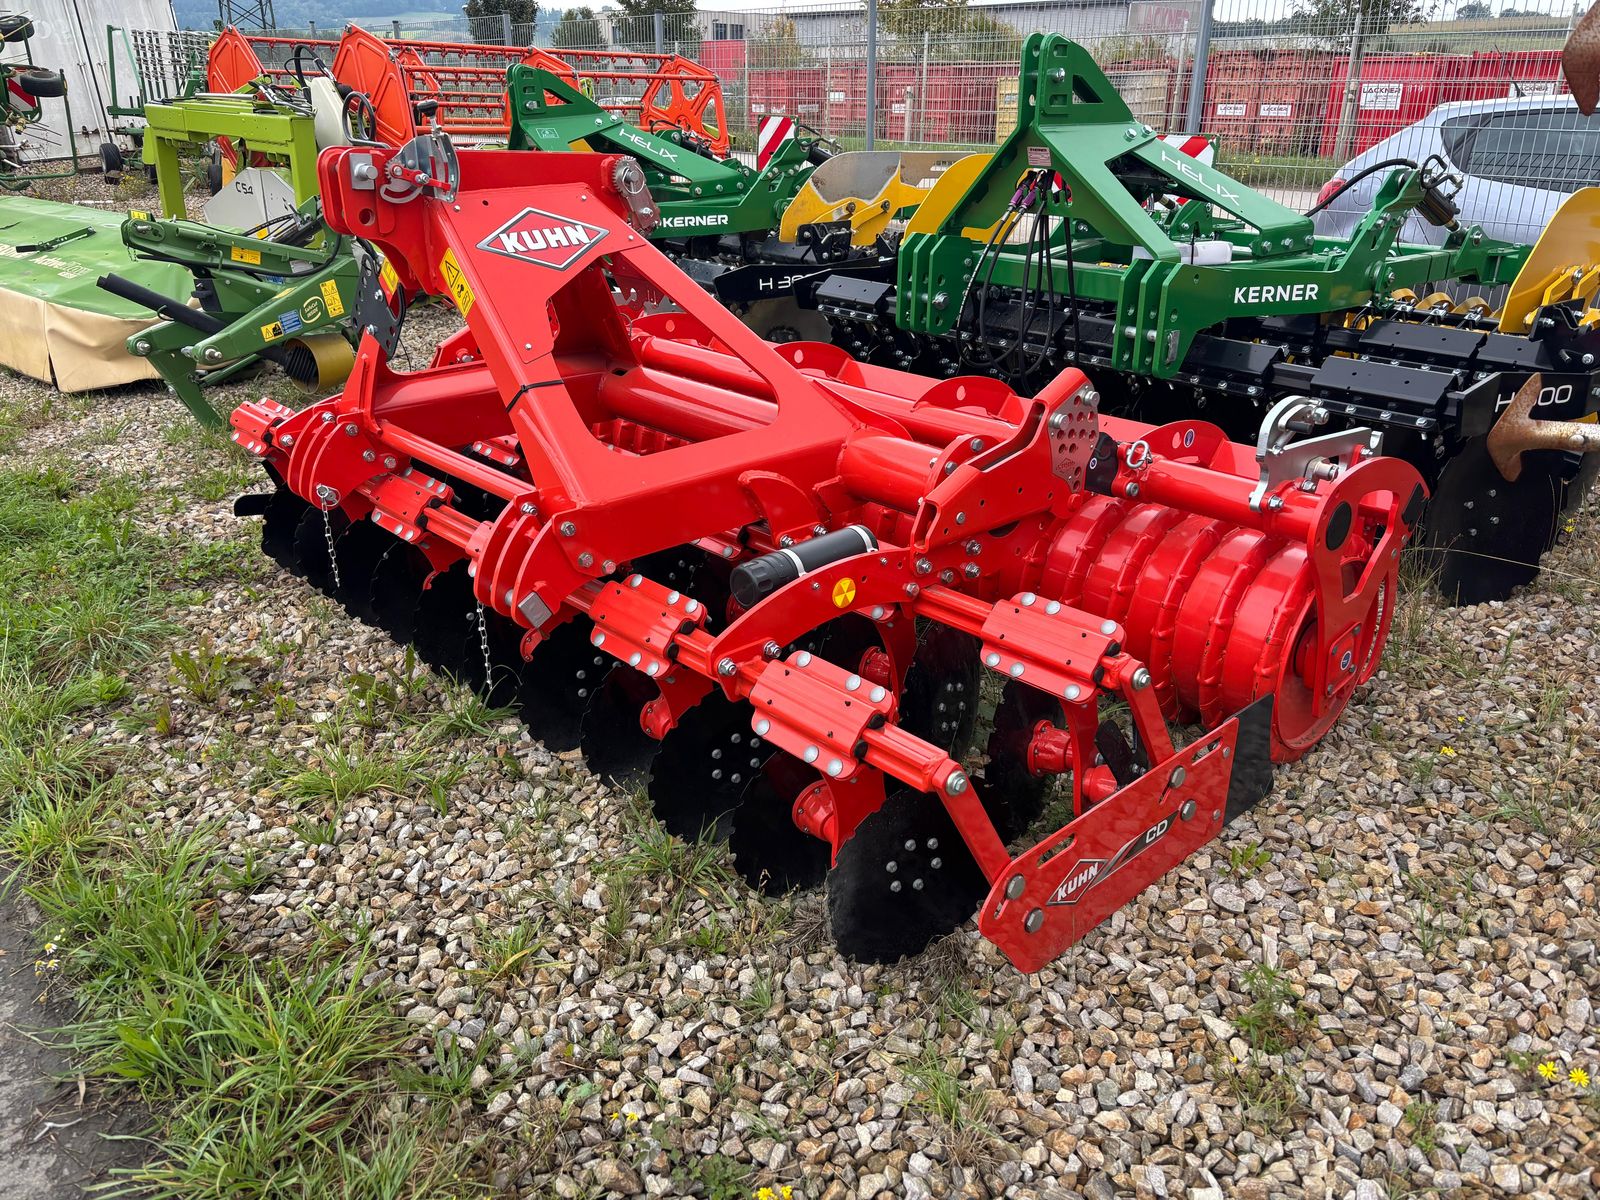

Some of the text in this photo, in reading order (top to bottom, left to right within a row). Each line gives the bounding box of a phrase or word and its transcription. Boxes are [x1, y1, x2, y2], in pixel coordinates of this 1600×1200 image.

[619, 128, 678, 163] HELIX
[1161, 150, 1240, 207] HELIX
[662, 214, 729, 228] KERNER
[498, 224, 592, 253] KUHN
[1233, 283, 1319, 304] KERNER
[1537, 384, 1573, 406] 00
[1145, 819, 1168, 844] CD
[1056, 862, 1099, 902] KUHN
